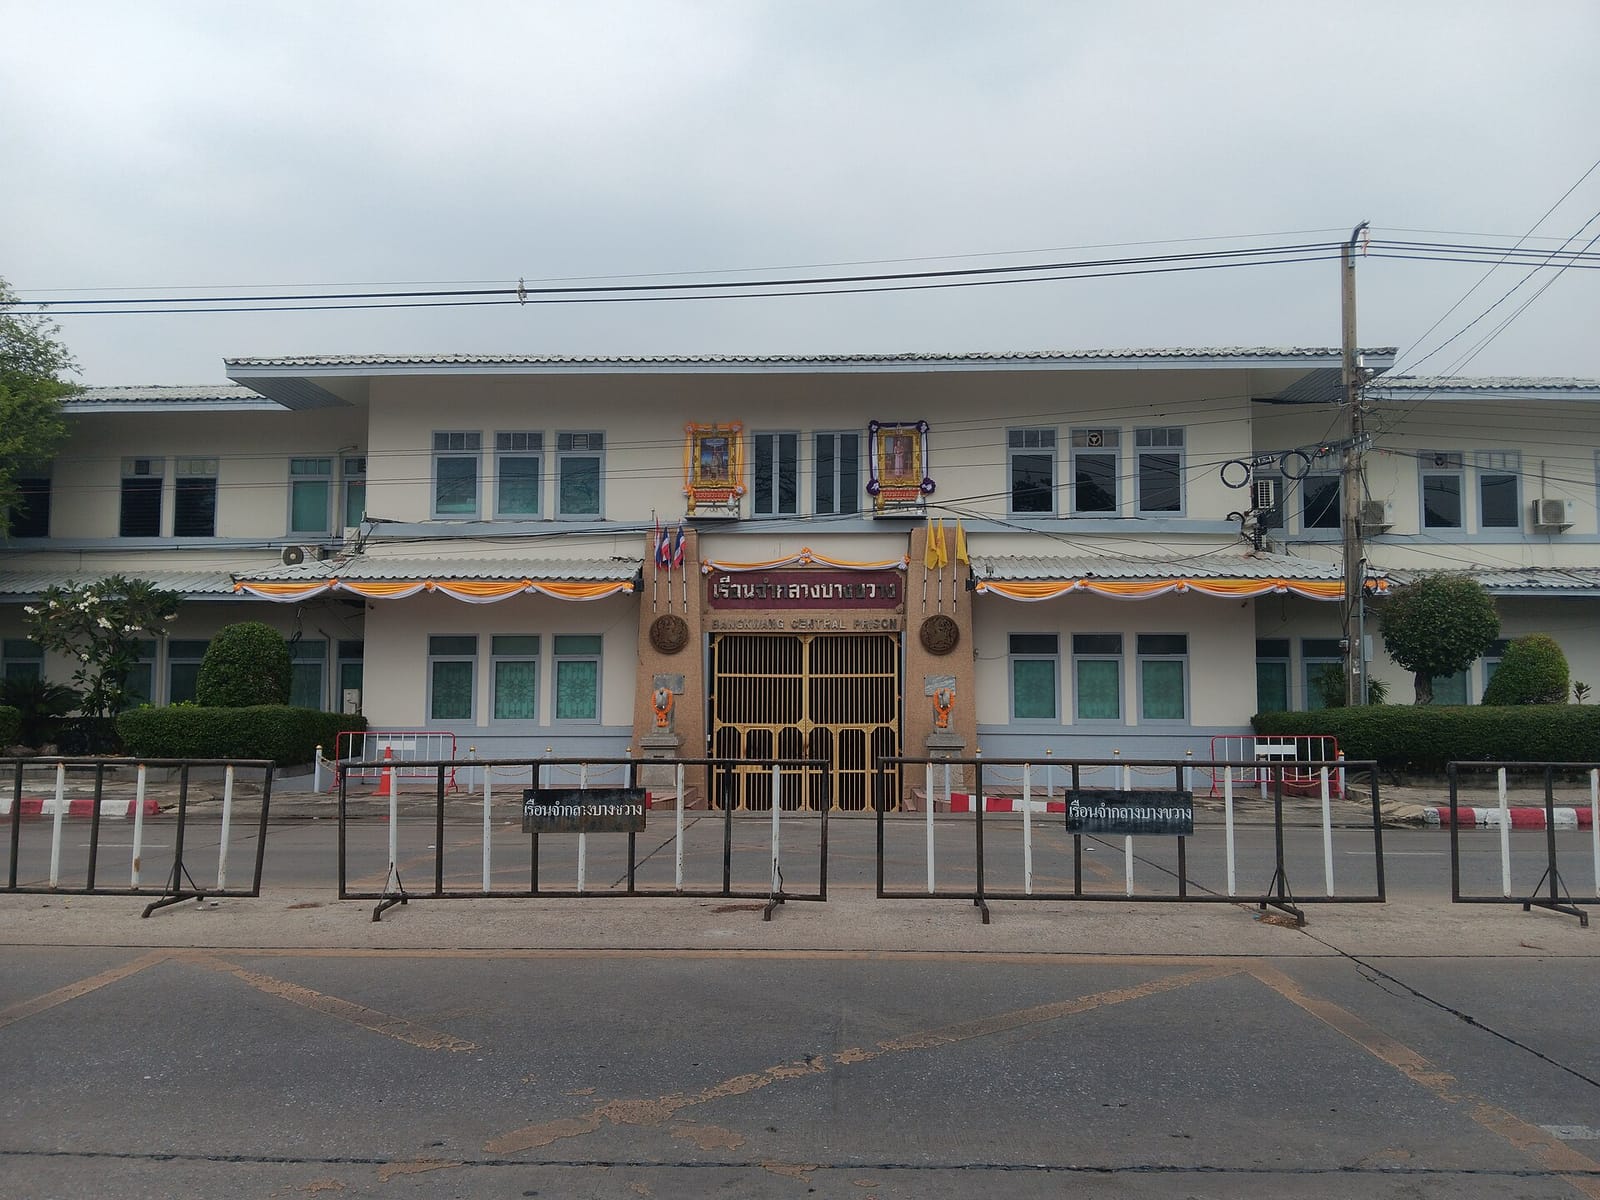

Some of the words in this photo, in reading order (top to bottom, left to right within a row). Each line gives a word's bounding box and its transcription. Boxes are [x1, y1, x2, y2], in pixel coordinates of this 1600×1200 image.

[712, 618, 784, 630] BANGKWANG
[791, 618, 847, 630] CENTRAL
[853, 618, 897, 630] PRISON
[1069, 799, 1192, 820] เรือนจำกลางบางขวาง
